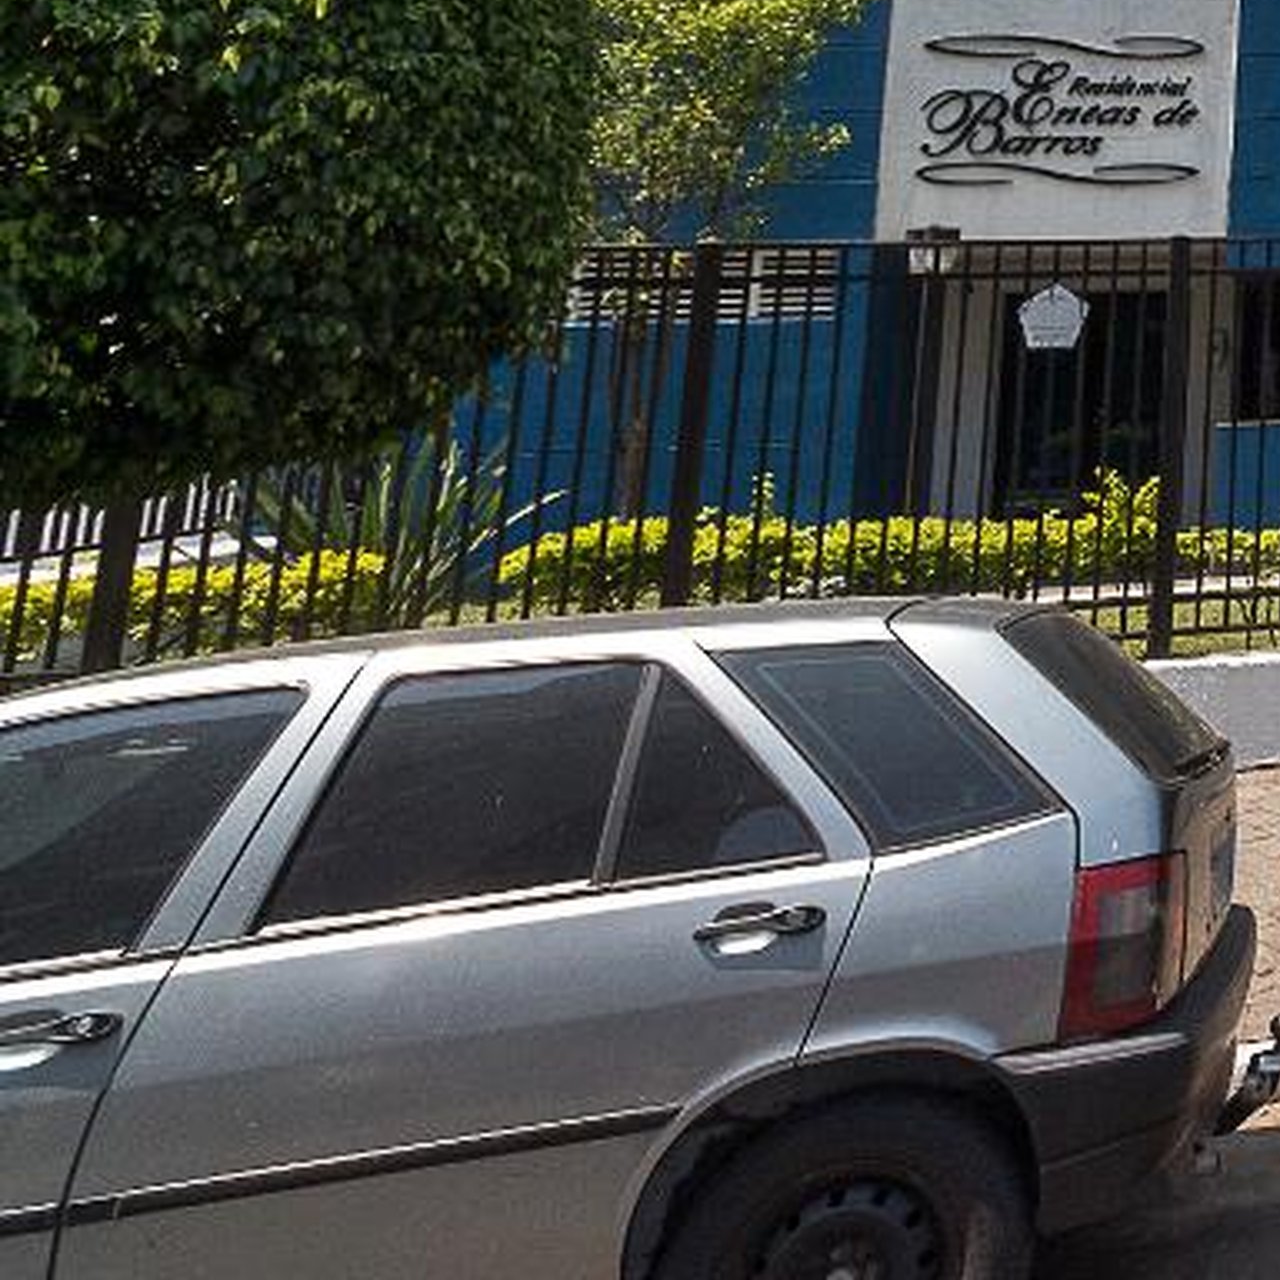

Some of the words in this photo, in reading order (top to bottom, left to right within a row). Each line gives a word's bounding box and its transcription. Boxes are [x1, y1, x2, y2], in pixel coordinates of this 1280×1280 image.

[1067, 75, 1192, 98] Residencial
[919, 89, 1103, 157] Barros
[1152, 99, 1200, 127] de
